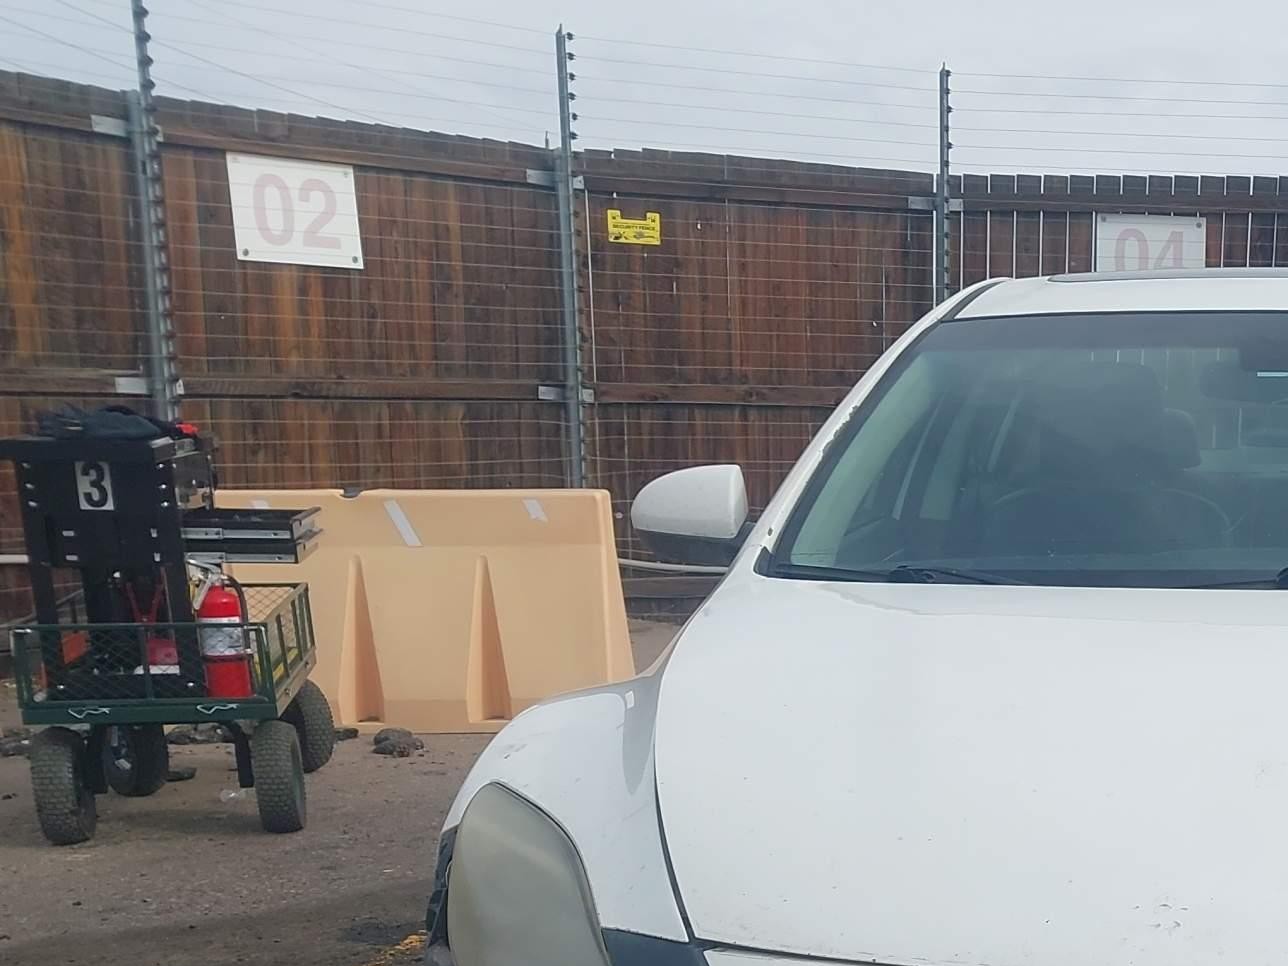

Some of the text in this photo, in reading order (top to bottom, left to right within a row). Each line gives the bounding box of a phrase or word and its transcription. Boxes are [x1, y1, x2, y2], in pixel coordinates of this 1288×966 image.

[253, 173, 342, 249] 02
[1115, 228, 1184, 271] 04
[81, 462, 108, 508] 3
